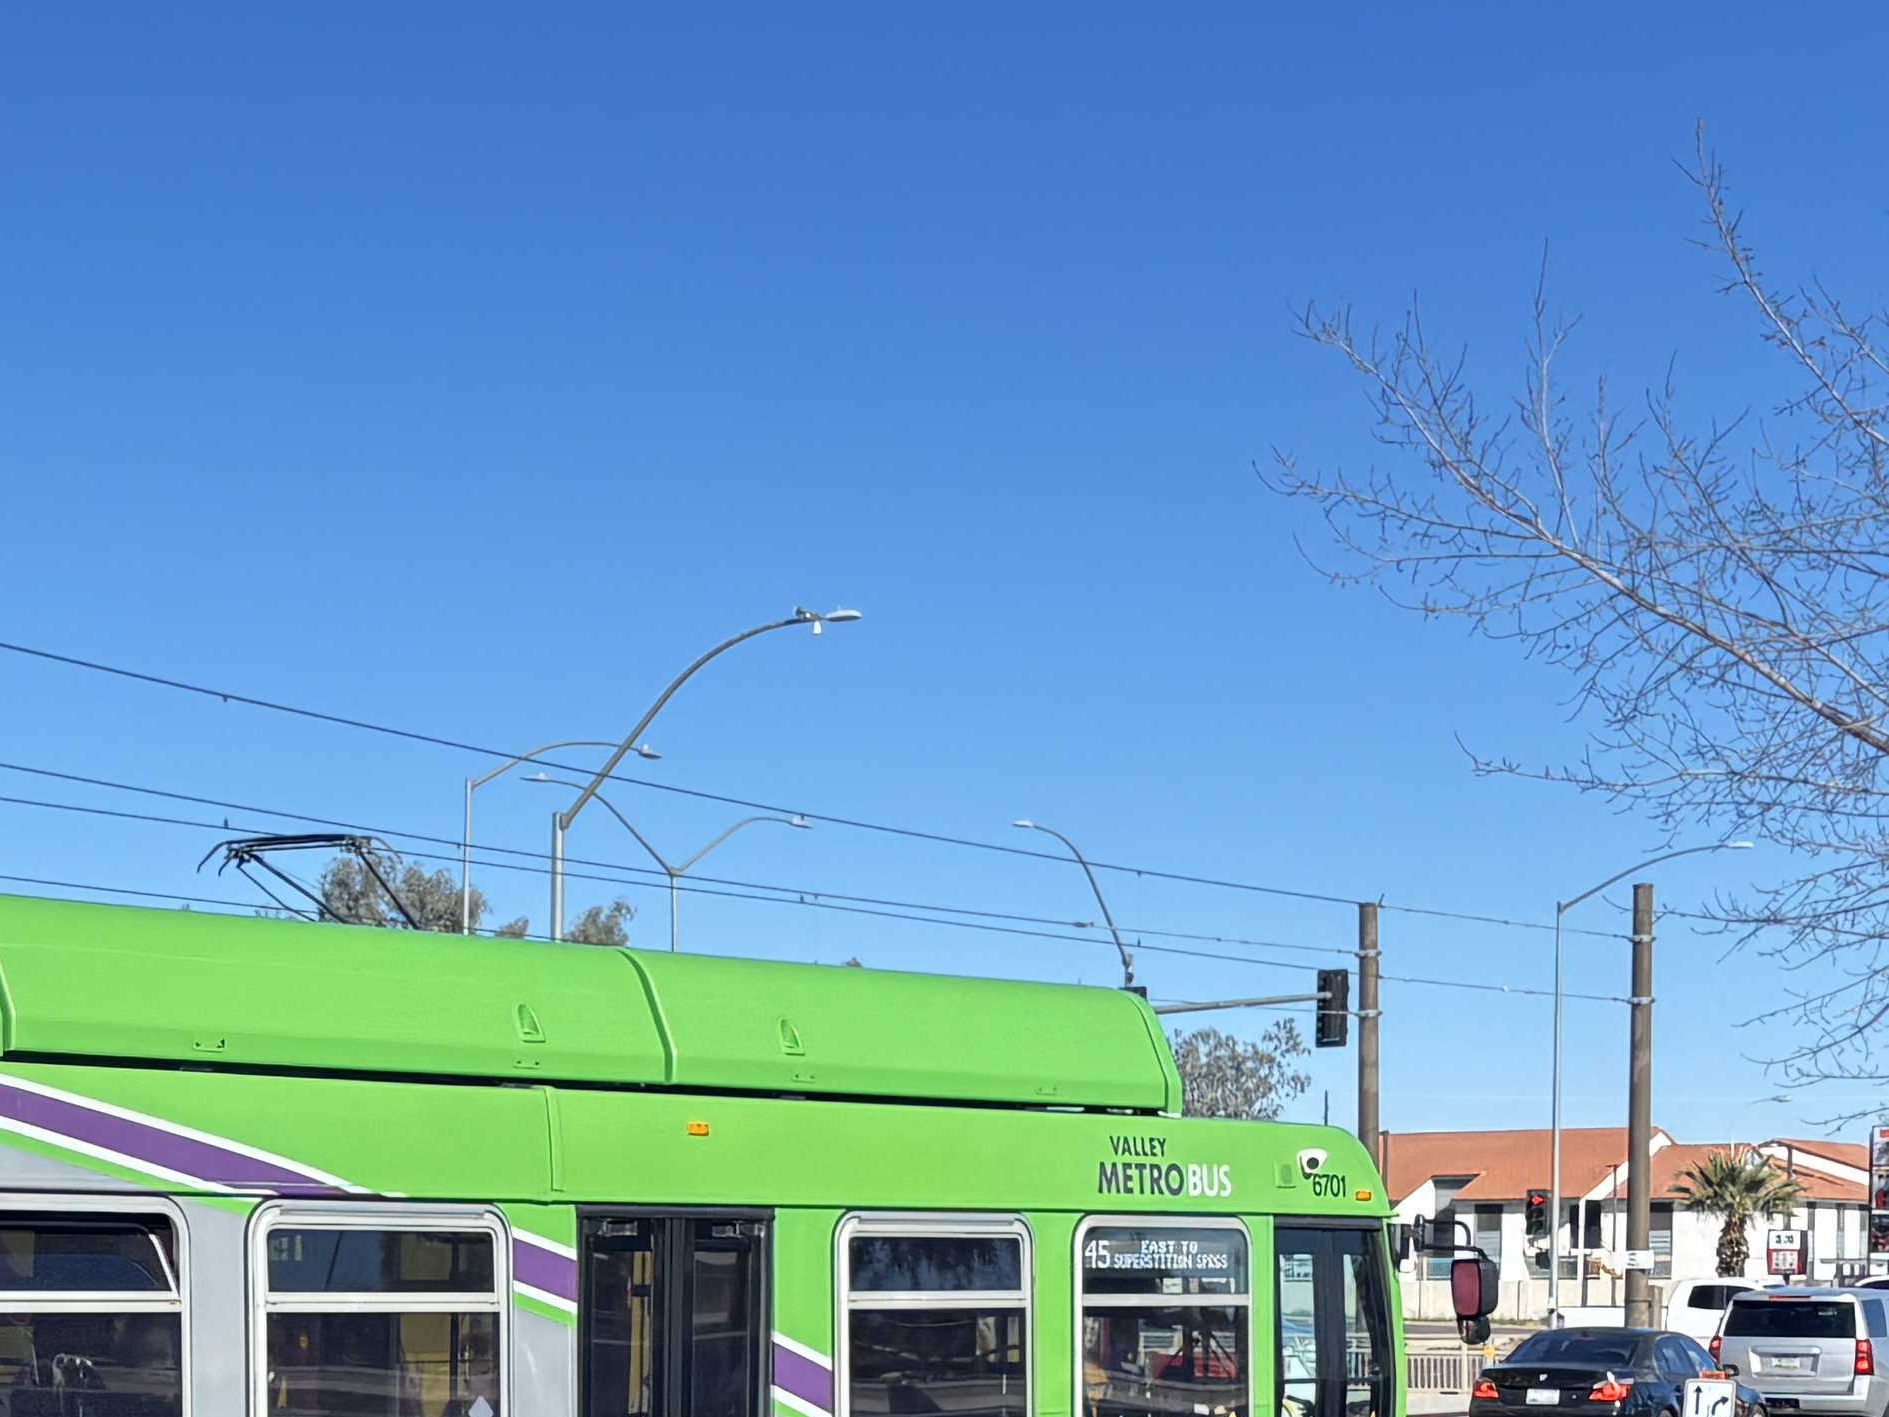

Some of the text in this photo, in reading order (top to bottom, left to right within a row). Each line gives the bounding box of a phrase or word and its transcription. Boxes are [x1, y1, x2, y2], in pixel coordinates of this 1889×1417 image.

[1109, 1135, 1166, 1157] VALLEY
[1312, 1174, 1347, 1198] 6701
[1084, 1240, 1110, 1269] 45
[1140, 1240, 1174, 1254] EAST
